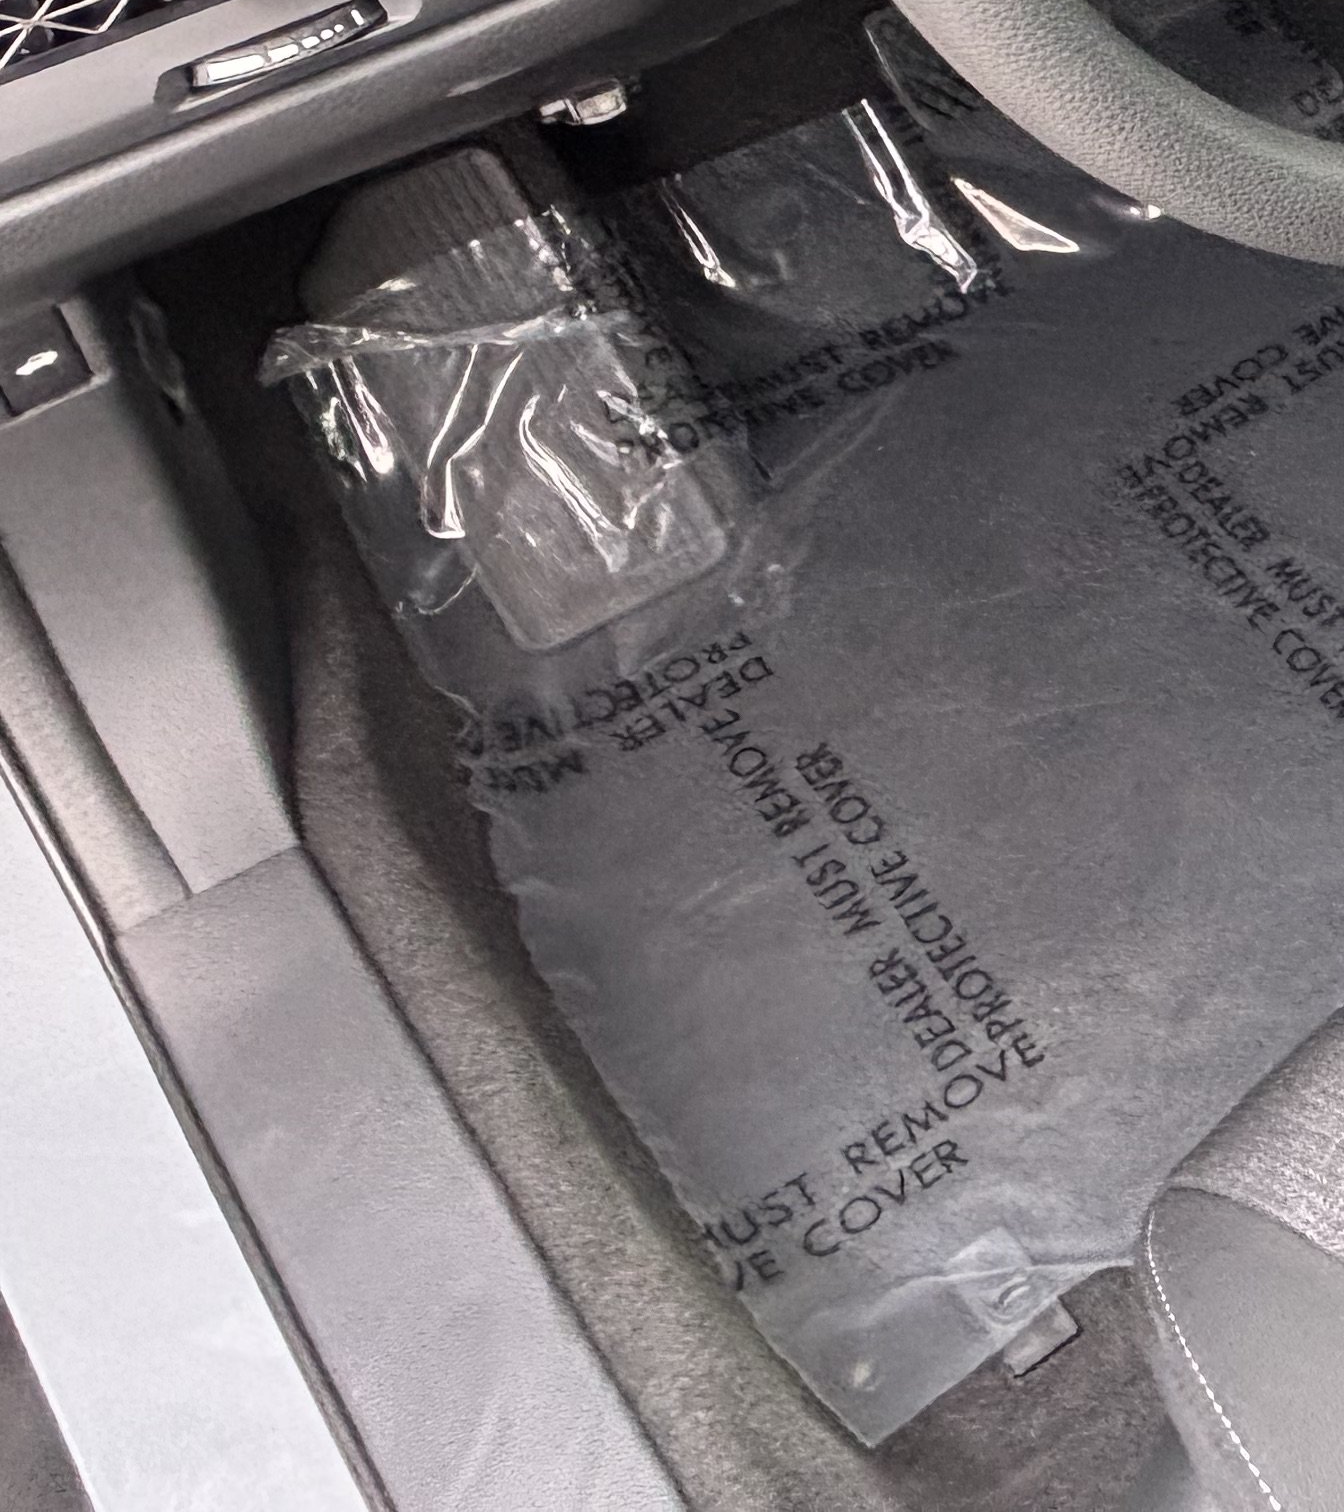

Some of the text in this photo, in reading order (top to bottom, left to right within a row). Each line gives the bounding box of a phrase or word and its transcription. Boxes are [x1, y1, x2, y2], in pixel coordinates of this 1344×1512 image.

[1117, 392, 1269, 488] REMOVE
[1173, 342, 1290, 417] COVER
[1136, 483, 1281, 631] PROTECTIVE
[1175, 458, 1271, 550] DEALER
[494, 631, 753, 754] PROTECTIVE
[608, 655, 775, 752] DEALER
[698, 707, 974, 1073] DEALER MUST REMOVE
[794, 741, 1026, 1045] PROTECTIVE COVER
[841, 1032, 1046, 1175] REMOVE
[802, 1139, 970, 1258] COVER
